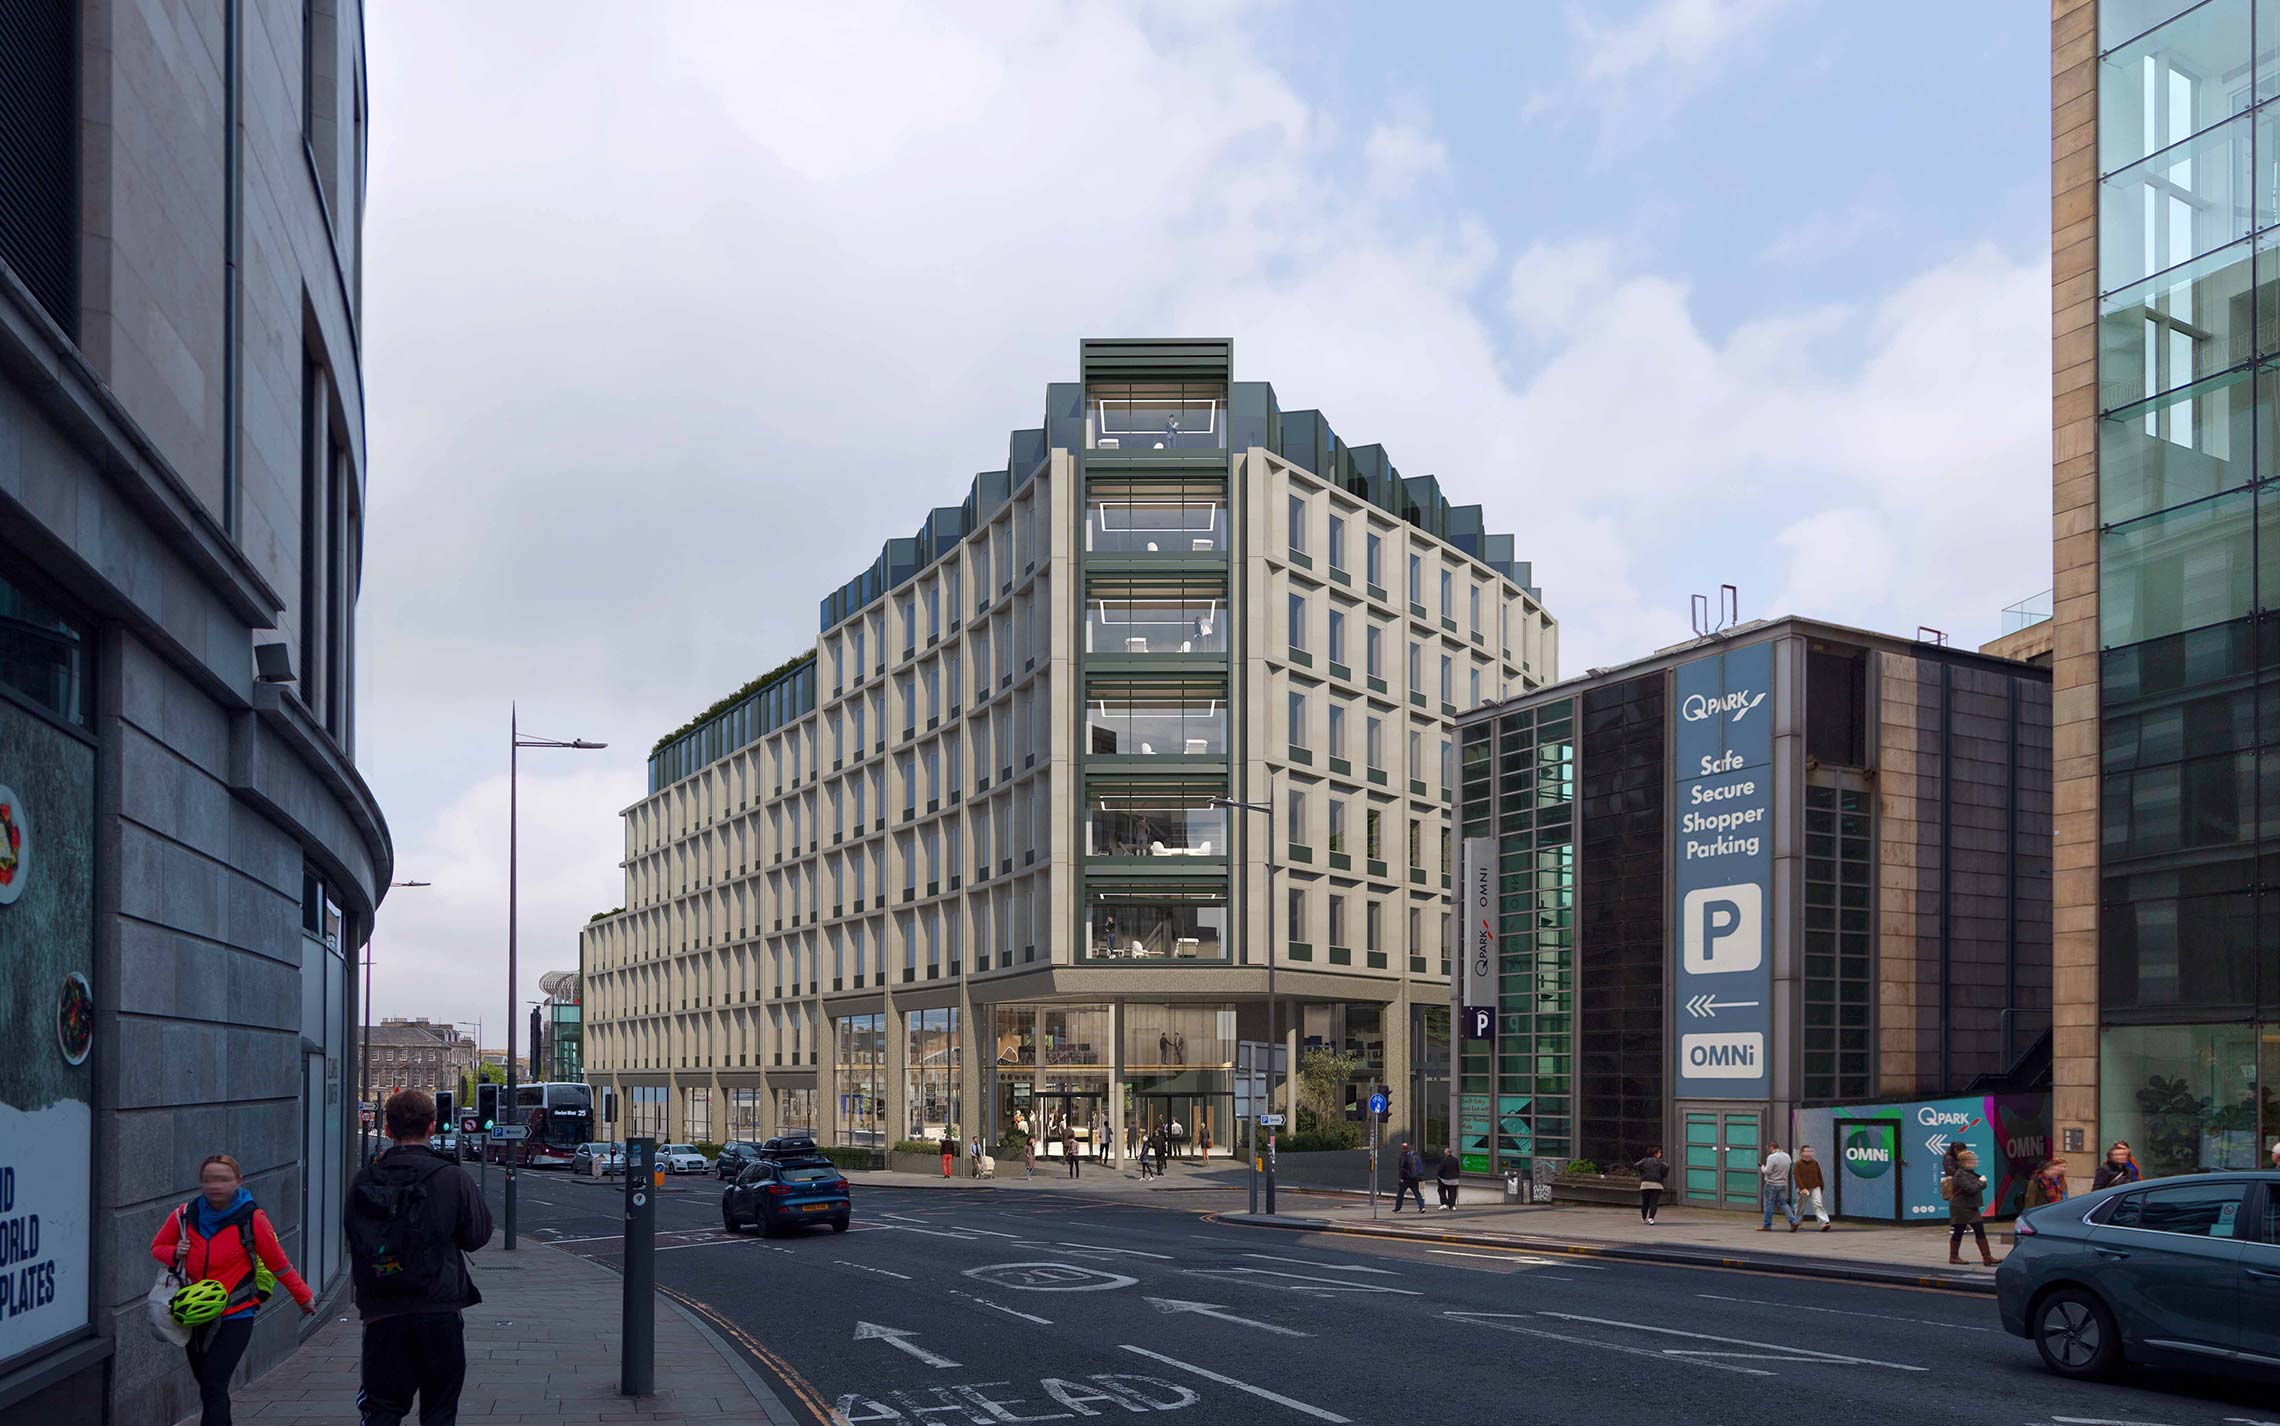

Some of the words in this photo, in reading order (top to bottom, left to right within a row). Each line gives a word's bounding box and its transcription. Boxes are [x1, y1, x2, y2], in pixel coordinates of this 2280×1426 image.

[1700, 750, 1744, 776] Safe
[1691, 780, 1755, 805] Secure
[1682, 808, 1765, 834] Shopper
[1686, 835, 1760, 860] Parking
[1479, 867, 1488, 908] OMNI
[1702, 899, 1741, 961] P
[1477, 1013, 1489, 1037] P
[1690, 1045, 1754, 1067] OMNi
[1917, 1106, 1969, 1126] QPARK
[1846, 1147, 1889, 1163] OMNi
[2006, 1135, 2044, 1159] OMNi
[0, 1166, 15, 1213] D
[0, 1259, 56, 1321] PLATES
[831, 1374, 1201, 1426] AHEAD
